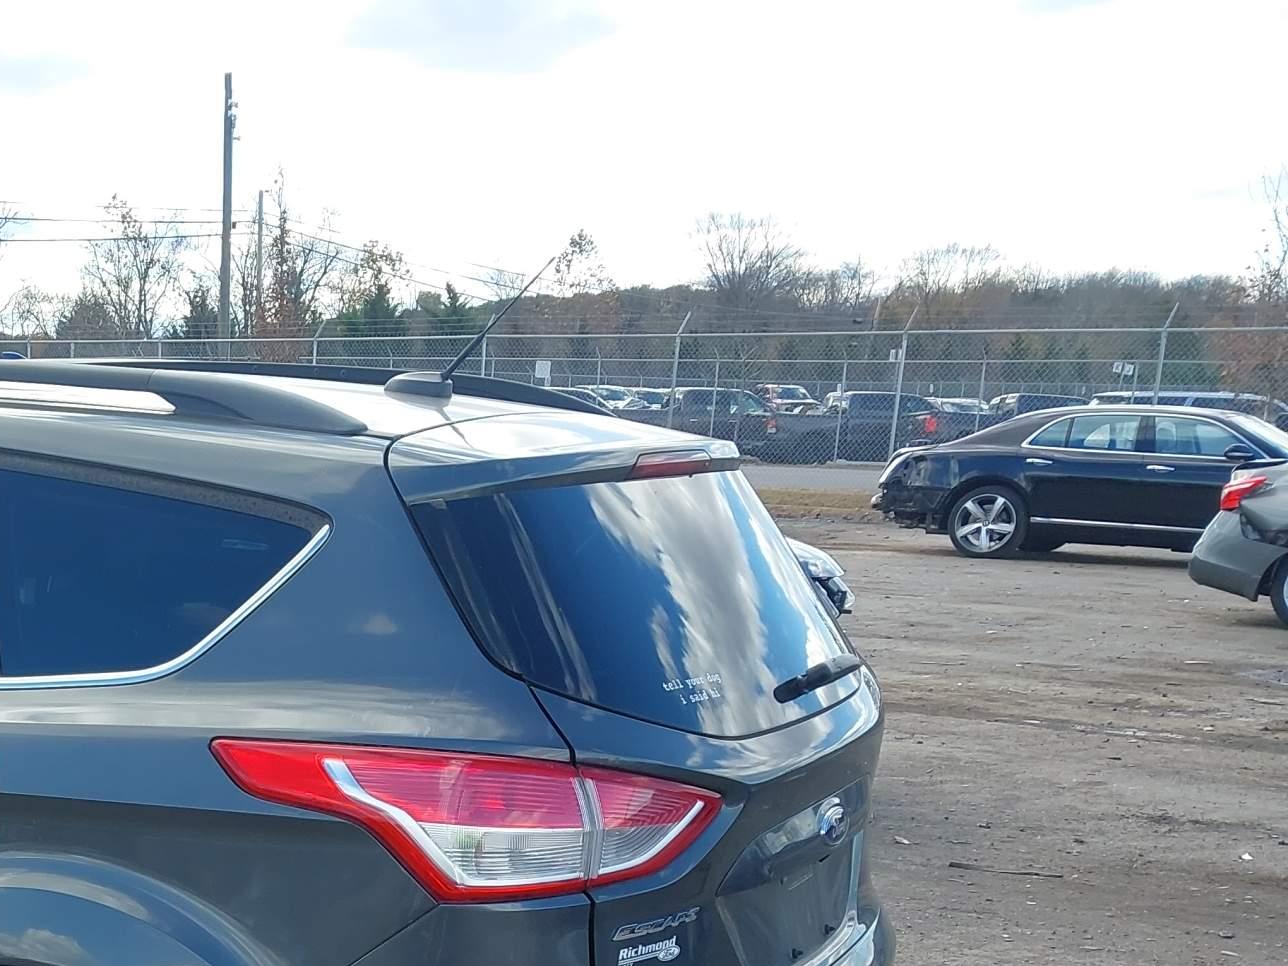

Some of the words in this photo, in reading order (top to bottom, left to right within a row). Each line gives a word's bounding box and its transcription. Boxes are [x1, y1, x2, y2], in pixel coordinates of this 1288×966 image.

[662, 678, 684, 691] tell
[685, 677, 705, 689] your
[706, 672, 722, 684] dog
[689, 689, 710, 703] said
[709, 687, 721, 698] hi
[618, 935, 677, 961] Richmond
